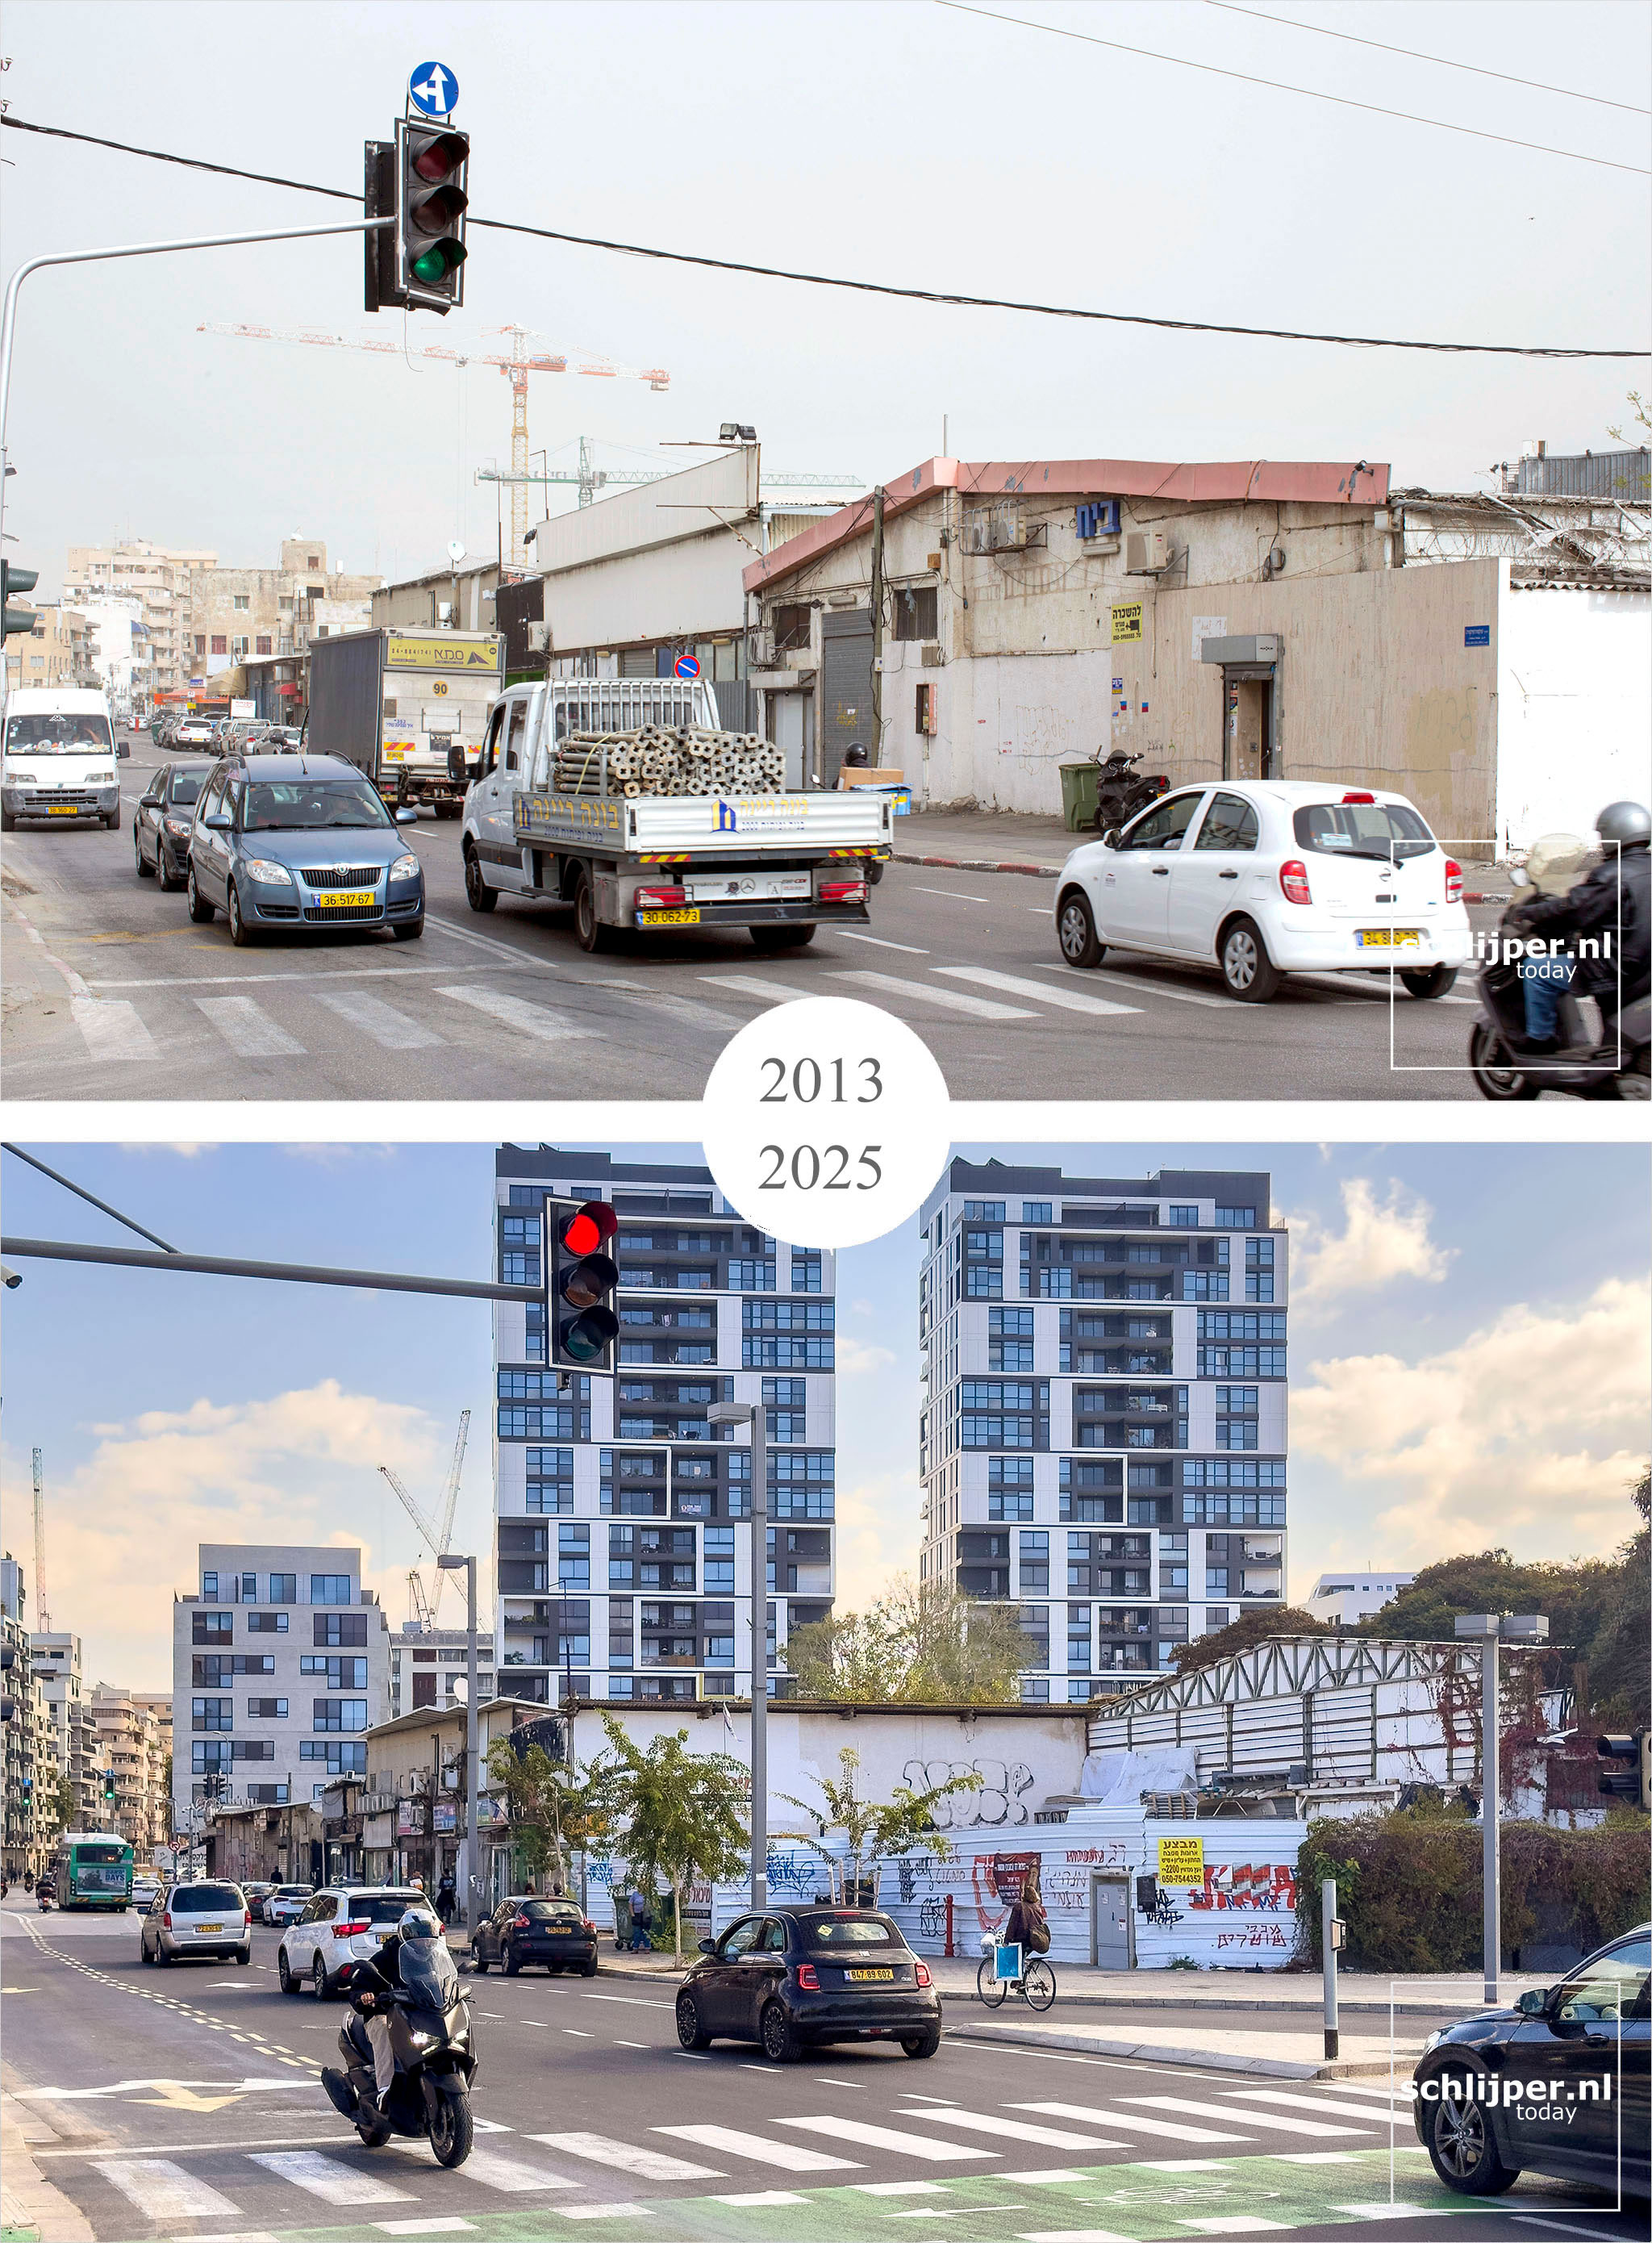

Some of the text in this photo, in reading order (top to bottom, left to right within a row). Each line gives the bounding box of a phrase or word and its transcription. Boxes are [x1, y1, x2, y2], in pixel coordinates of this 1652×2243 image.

[1112, 604, 1141, 620] להשכרה
[433, 683, 448, 695] 90
[580, 799, 620, 830] בונה
[1163, 1840, 1198, 1849] מבצע
[1245, 1924, 1282, 1935] מכבי
